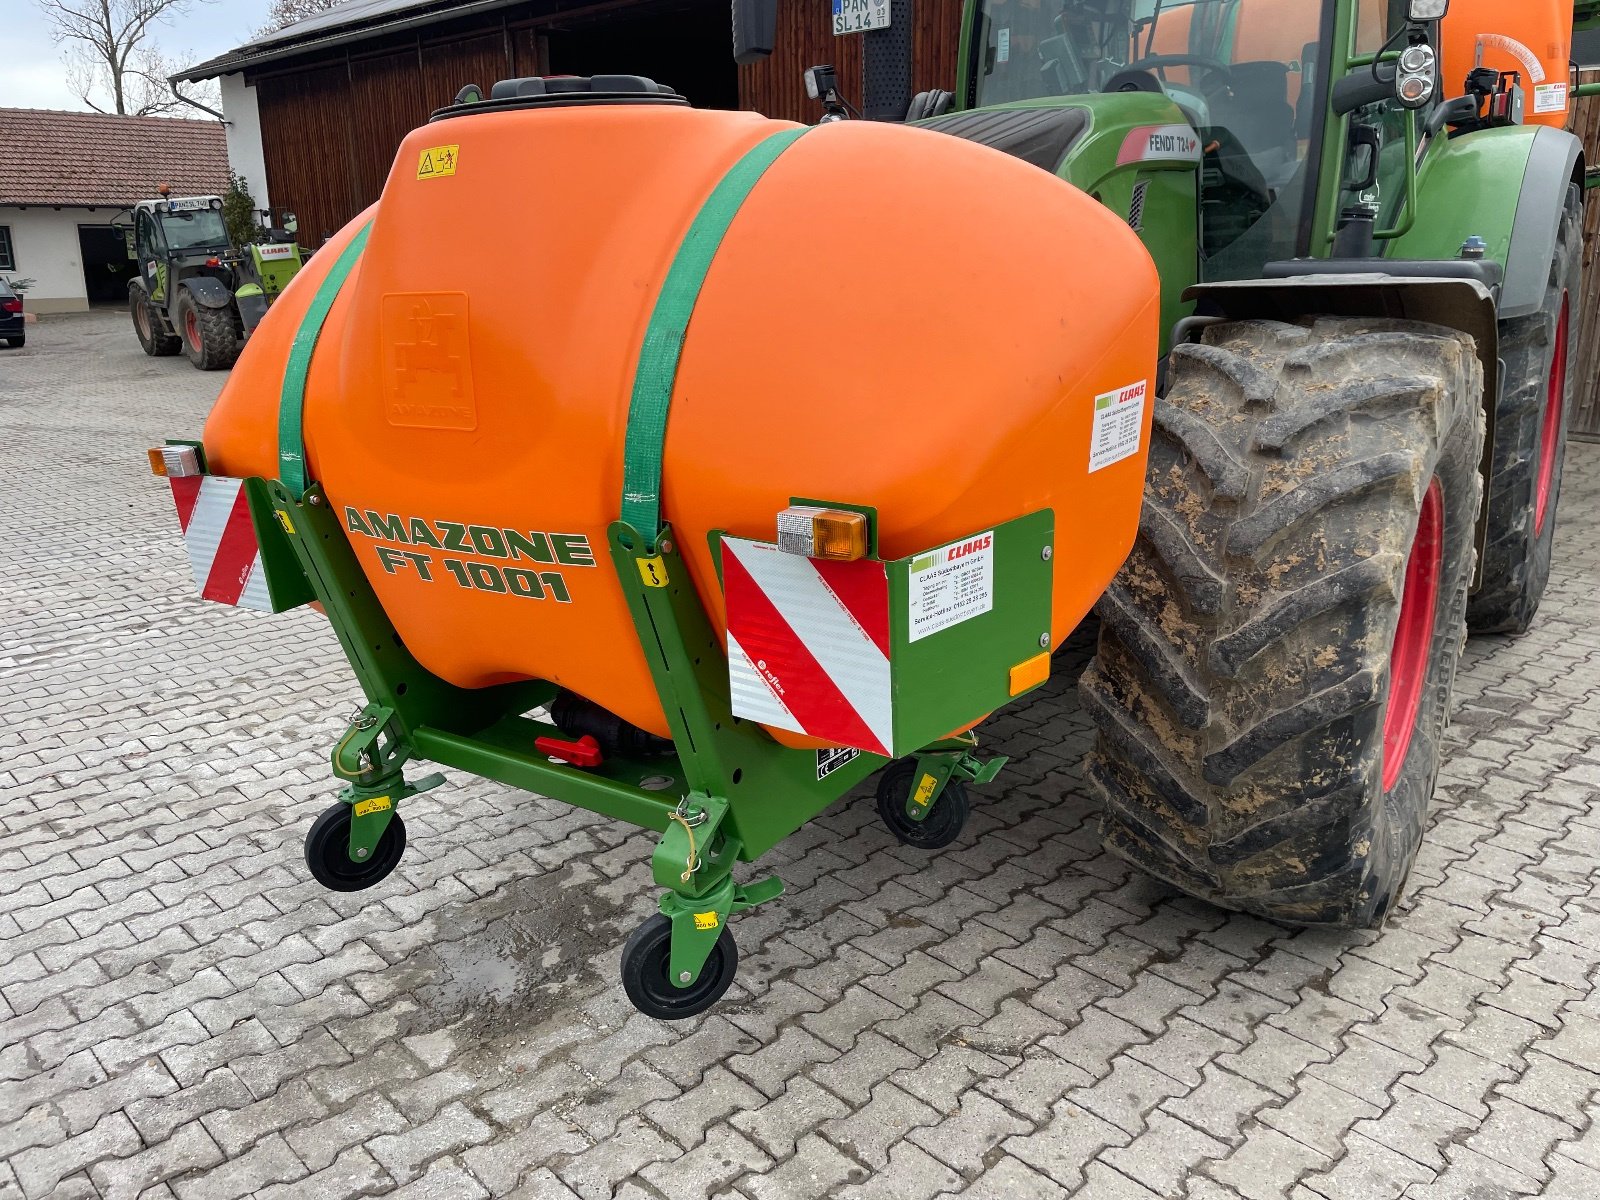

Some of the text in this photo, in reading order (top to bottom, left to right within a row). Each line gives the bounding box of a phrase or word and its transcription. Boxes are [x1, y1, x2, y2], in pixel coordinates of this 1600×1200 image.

[843, 0, 868, 14] PAN
[836, 12, 871, 32] SL 14
[1149, 135, 1190, 152] FENDT 724
[261, 247, 290, 255] CLAAS
[1119, 384, 1145, 403] CLAAS
[344, 506, 597, 567] AMAZONE
[948, 535, 991, 561] CLAAS
[374, 545, 572, 604] FT 1001
[919, 571, 937, 583] CLAAS
[764, 668, 787, 696] reflex
